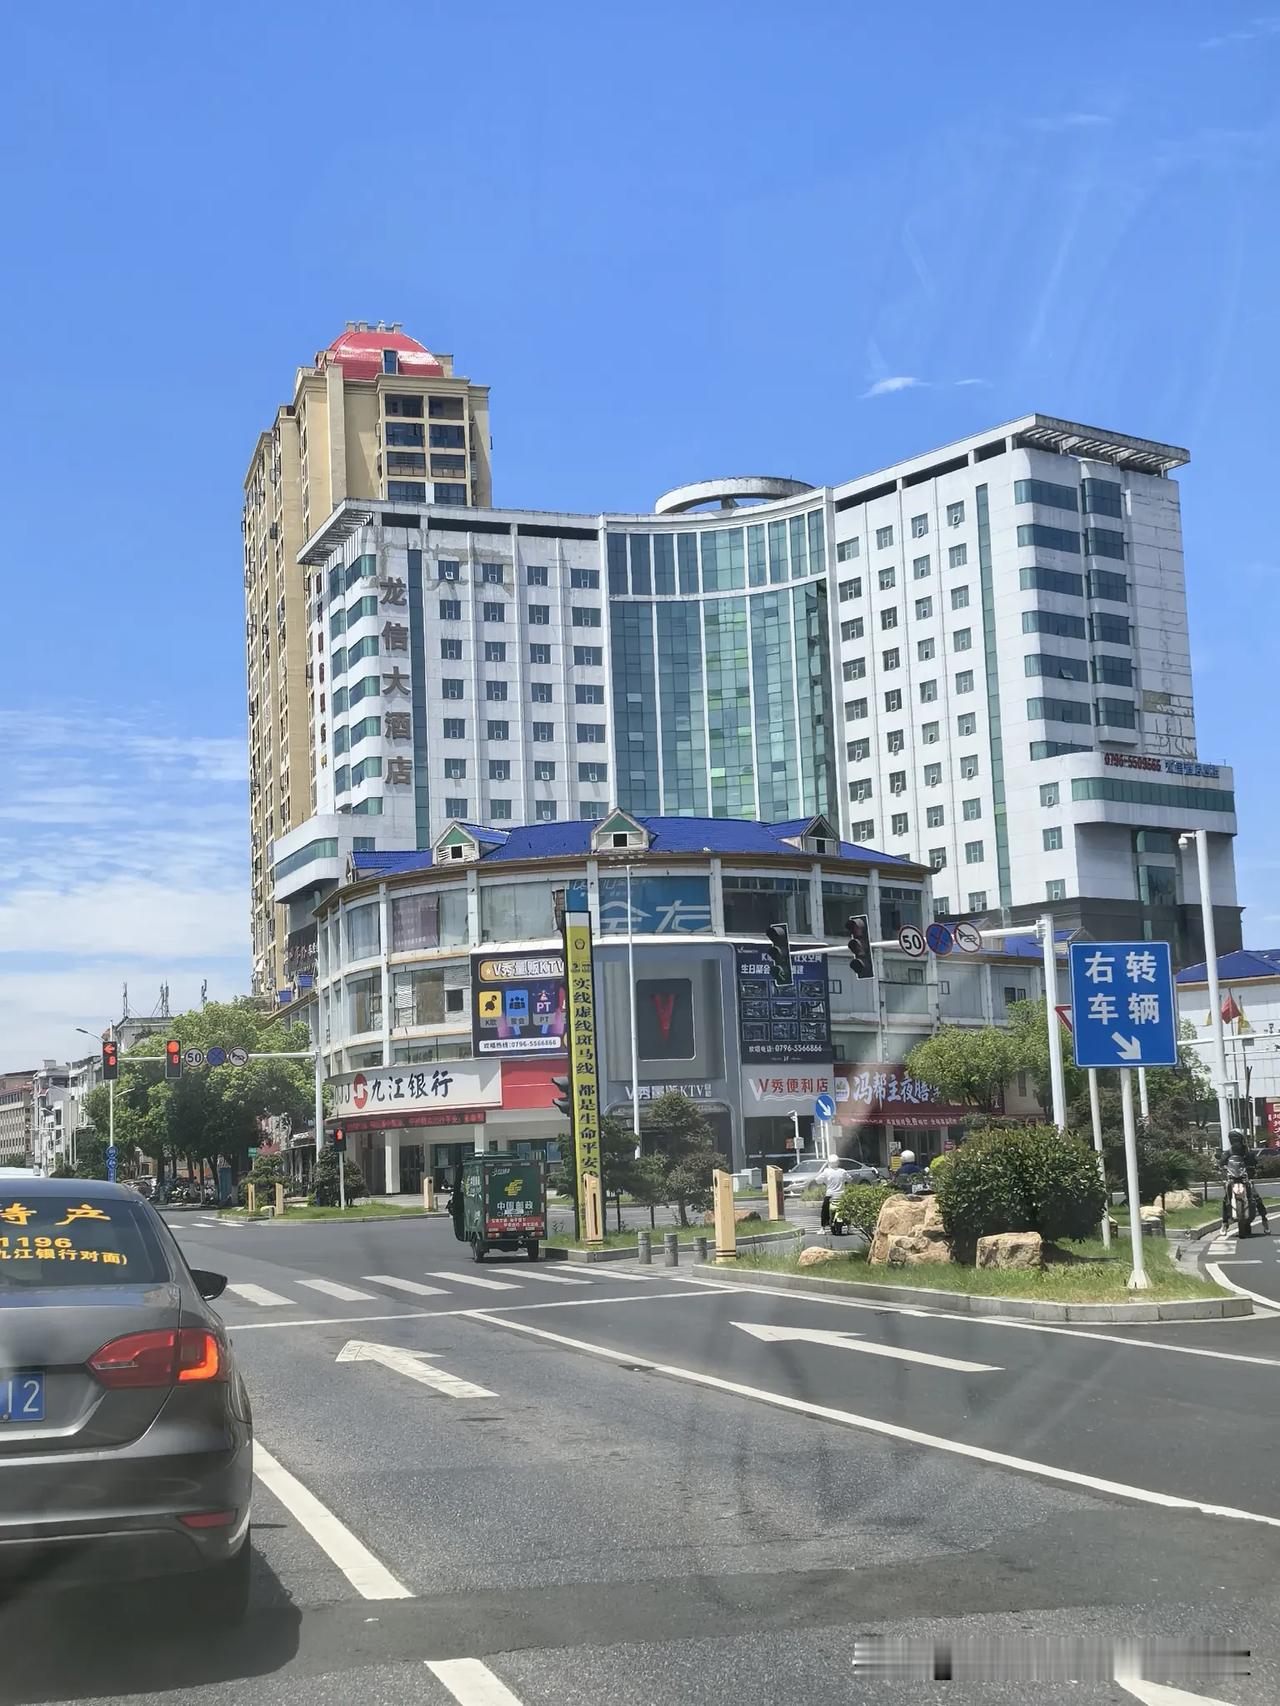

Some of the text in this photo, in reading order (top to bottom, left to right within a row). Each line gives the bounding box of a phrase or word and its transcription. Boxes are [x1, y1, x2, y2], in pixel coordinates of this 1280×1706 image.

[379, 576, 413, 785] 龙信大酒店
[902, 934, 921, 950] 50
[1084, 951, 1158, 984] 右转
[536, 1001, 551, 1013] PT
[1087, 993, 1160, 1025] 车辆
[573, 978, 595, 1075] 实线虚线斑马线
[188, 1052, 201, 1063] 50
[371, 1070, 453, 1102] 九江银行
[578, 1084, 599, 1178] 都是生命平安
[8, 1380, 40, 1413] 12
